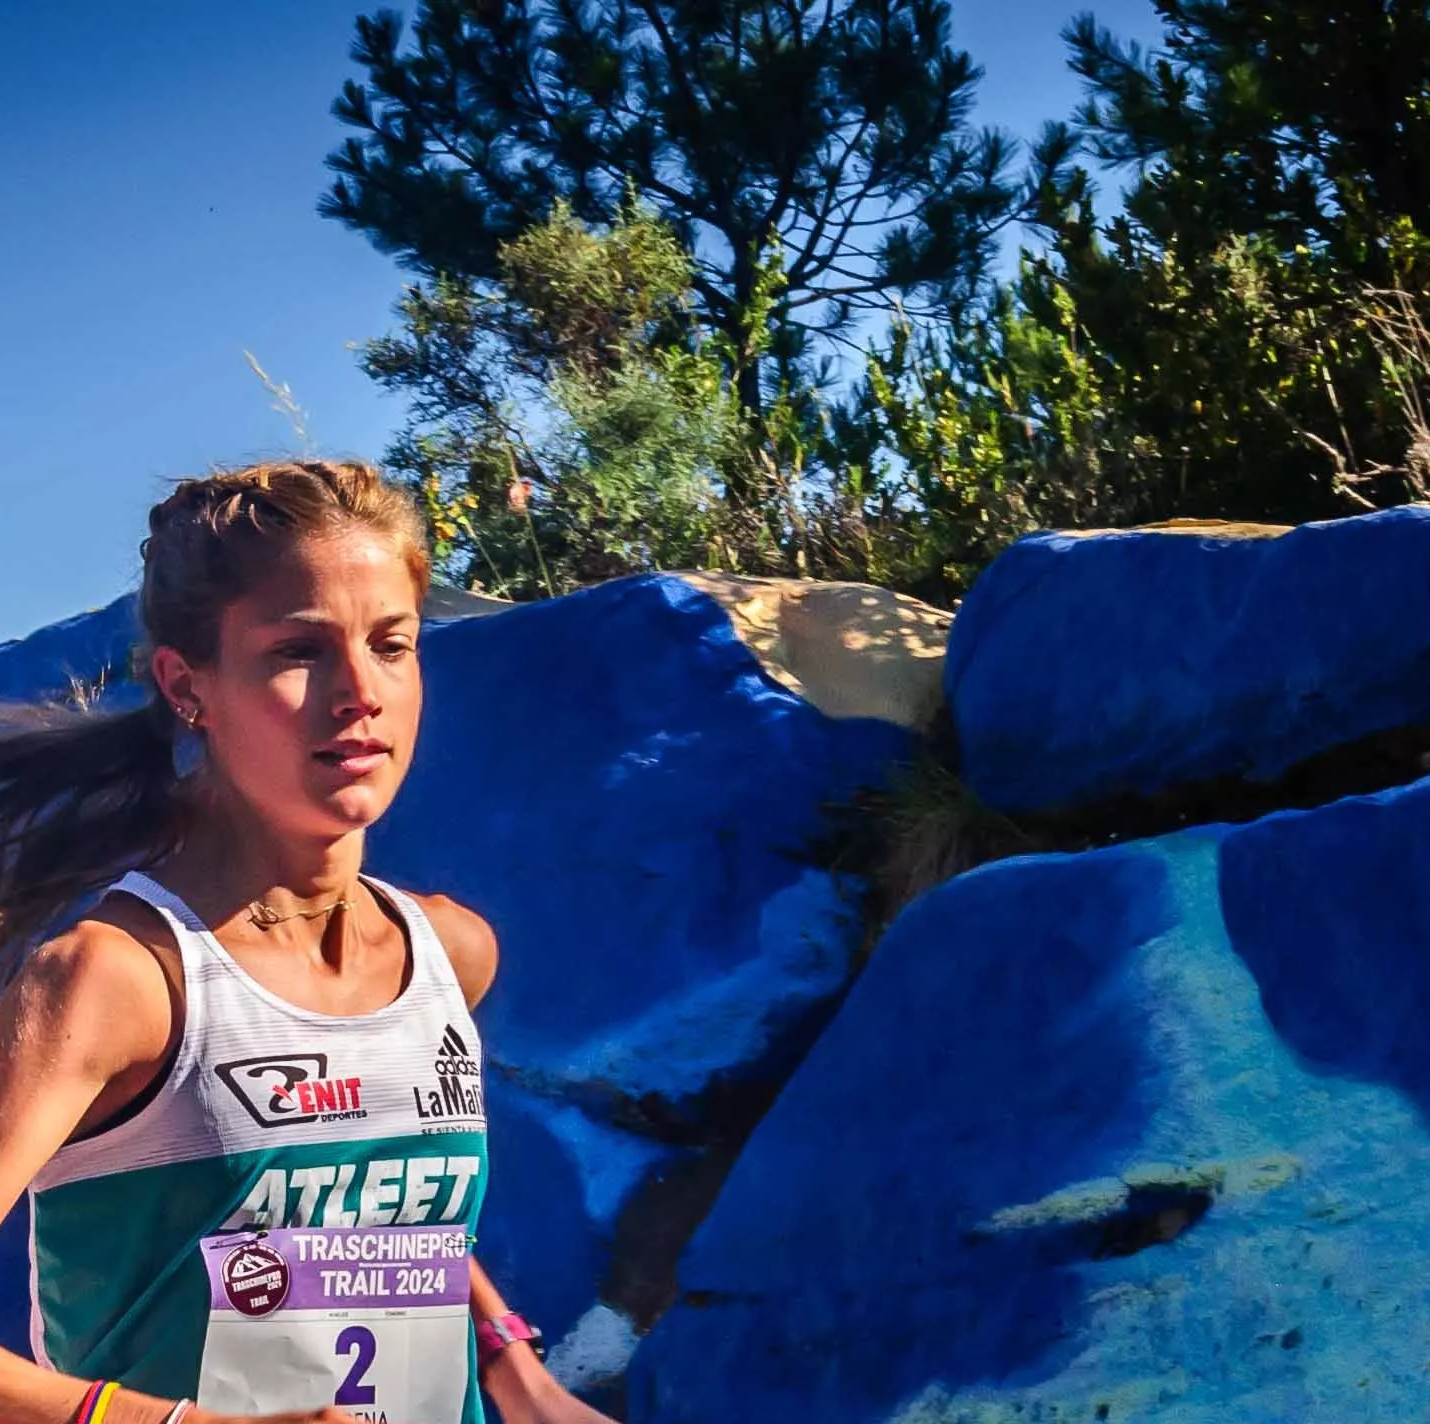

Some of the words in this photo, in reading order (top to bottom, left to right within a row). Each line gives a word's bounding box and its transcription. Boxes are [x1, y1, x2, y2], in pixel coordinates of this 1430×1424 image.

[321, 1109, 368, 1123] DEPORTES
[219, 1156, 480, 1229] ATLEET
[292, 1232, 466, 1262] TRASCHINEPRO
[321, 1269, 390, 1297] TRAIL
[396, 1268, 446, 1295] 2024
[334, 1326, 376, 1406] 2
